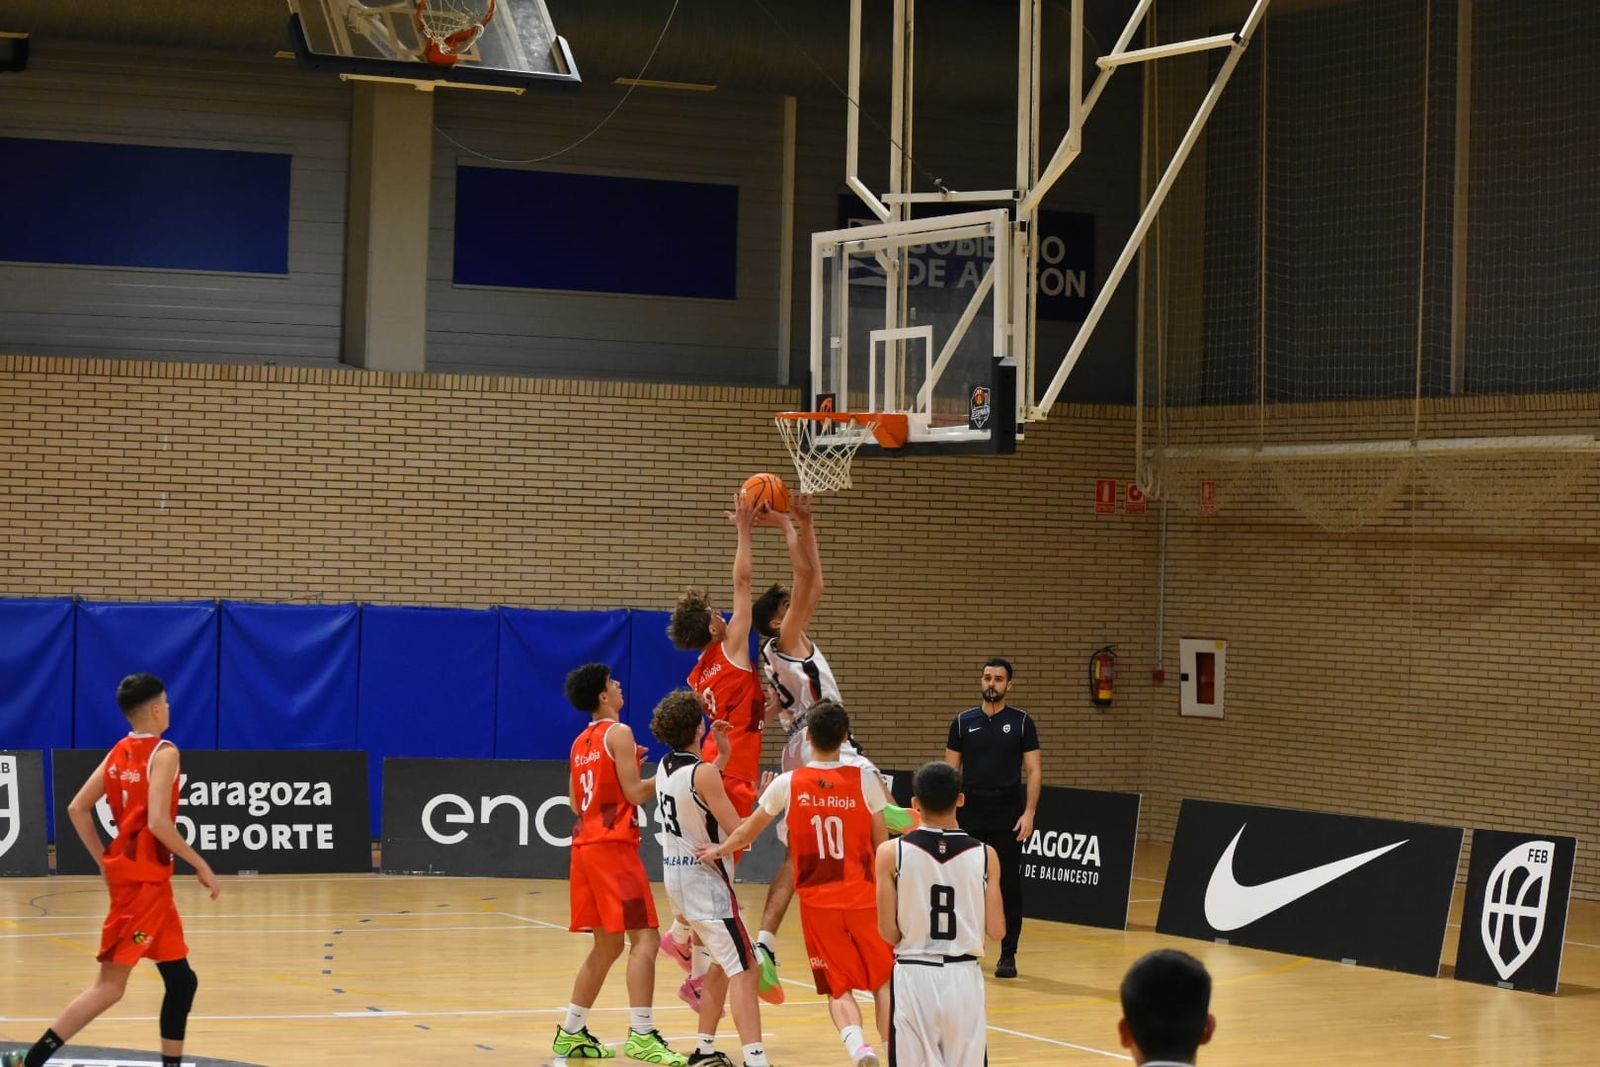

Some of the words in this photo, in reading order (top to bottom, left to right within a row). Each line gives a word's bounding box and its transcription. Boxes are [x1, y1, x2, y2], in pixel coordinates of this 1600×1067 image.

[178, 774, 332, 816] Zaragoza
[812, 795, 825, 807] La
[827, 796, 856, 809] Rioja
[174, 815, 334, 850] DEPORTE
[810, 814, 845, 860] 10
[1021, 829, 1101, 868] AGOZA
[1528, 848, 1549, 864] FEB
[1025, 864, 1037, 878] DE
[1040, 865, 1100, 886] BALONCESTO
[929, 883, 957, 941] 8
